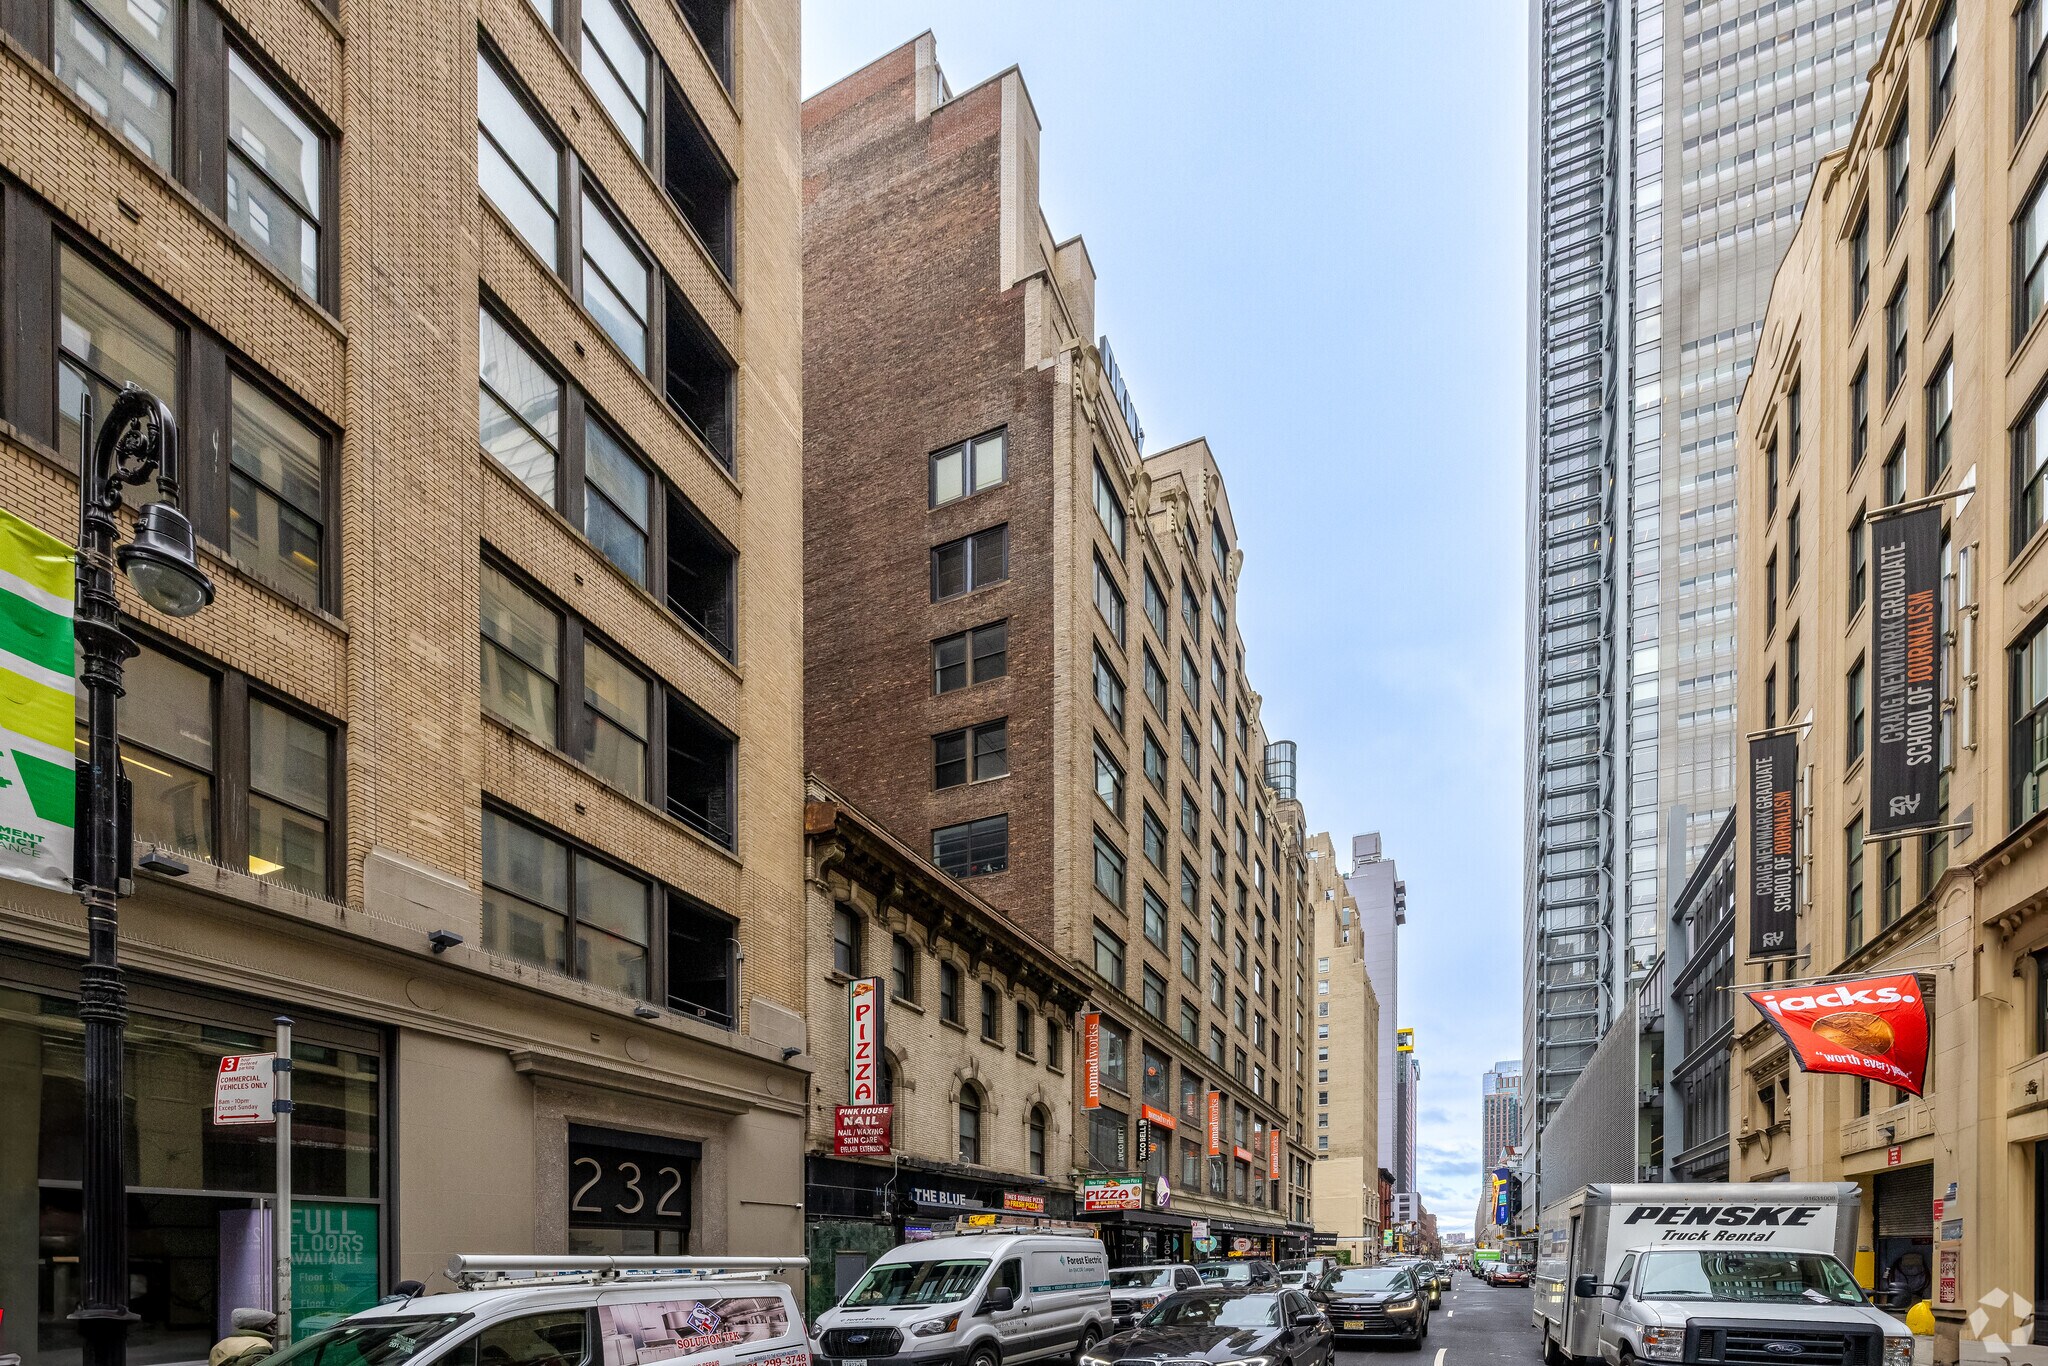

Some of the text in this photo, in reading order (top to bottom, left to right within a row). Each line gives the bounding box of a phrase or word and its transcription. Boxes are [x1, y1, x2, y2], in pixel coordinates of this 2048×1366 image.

[1880, 541, 1905, 744] CRAIG NEWMARK GRADUATE
[1907, 590, 1933, 766] SCHOOL OF JOURNALISM
[1756, 756, 1773, 895] CRAIG NEWMARK GRADUATE
[1774, 790, 1791, 912] SCHOOL OF JOURNALISM
[1762, 986, 1915, 1016] jacks.
[855, 1004, 871, 1100] PIZZA
[1086, 1023, 1099, 1098] nomadworks
[224, 1058, 235, 1071] 3
[221, 1075, 260, 1083] COMMERCIAL
[843, 1116, 879, 1126] NAIL
[1209, 1099, 1218, 1149] nomadworks
[1139, 1124, 1147, 1160] TACO BELL
[572, 1157, 681, 1216] 232
[1086, 1190, 1129, 1200] PIZZA
[915, 1188, 966, 1205] THE BLUE
[1026, 1201, 1038, 1209] PIZZA
[291, 1208, 356, 1235] FULL
[1623, 1206, 1822, 1226] PENSKE
[291, 1233, 364, 1252] FLOORS
[1661, 1229, 1776, 1242] Truck Rental
[1067, 1255, 1102, 1264] Forest Electric
[299, 1272, 323, 1282] Floor
[676, 1331, 740, 1349] SOLUTION TEK
[742, 1353, 807, 1366] -299-3748
